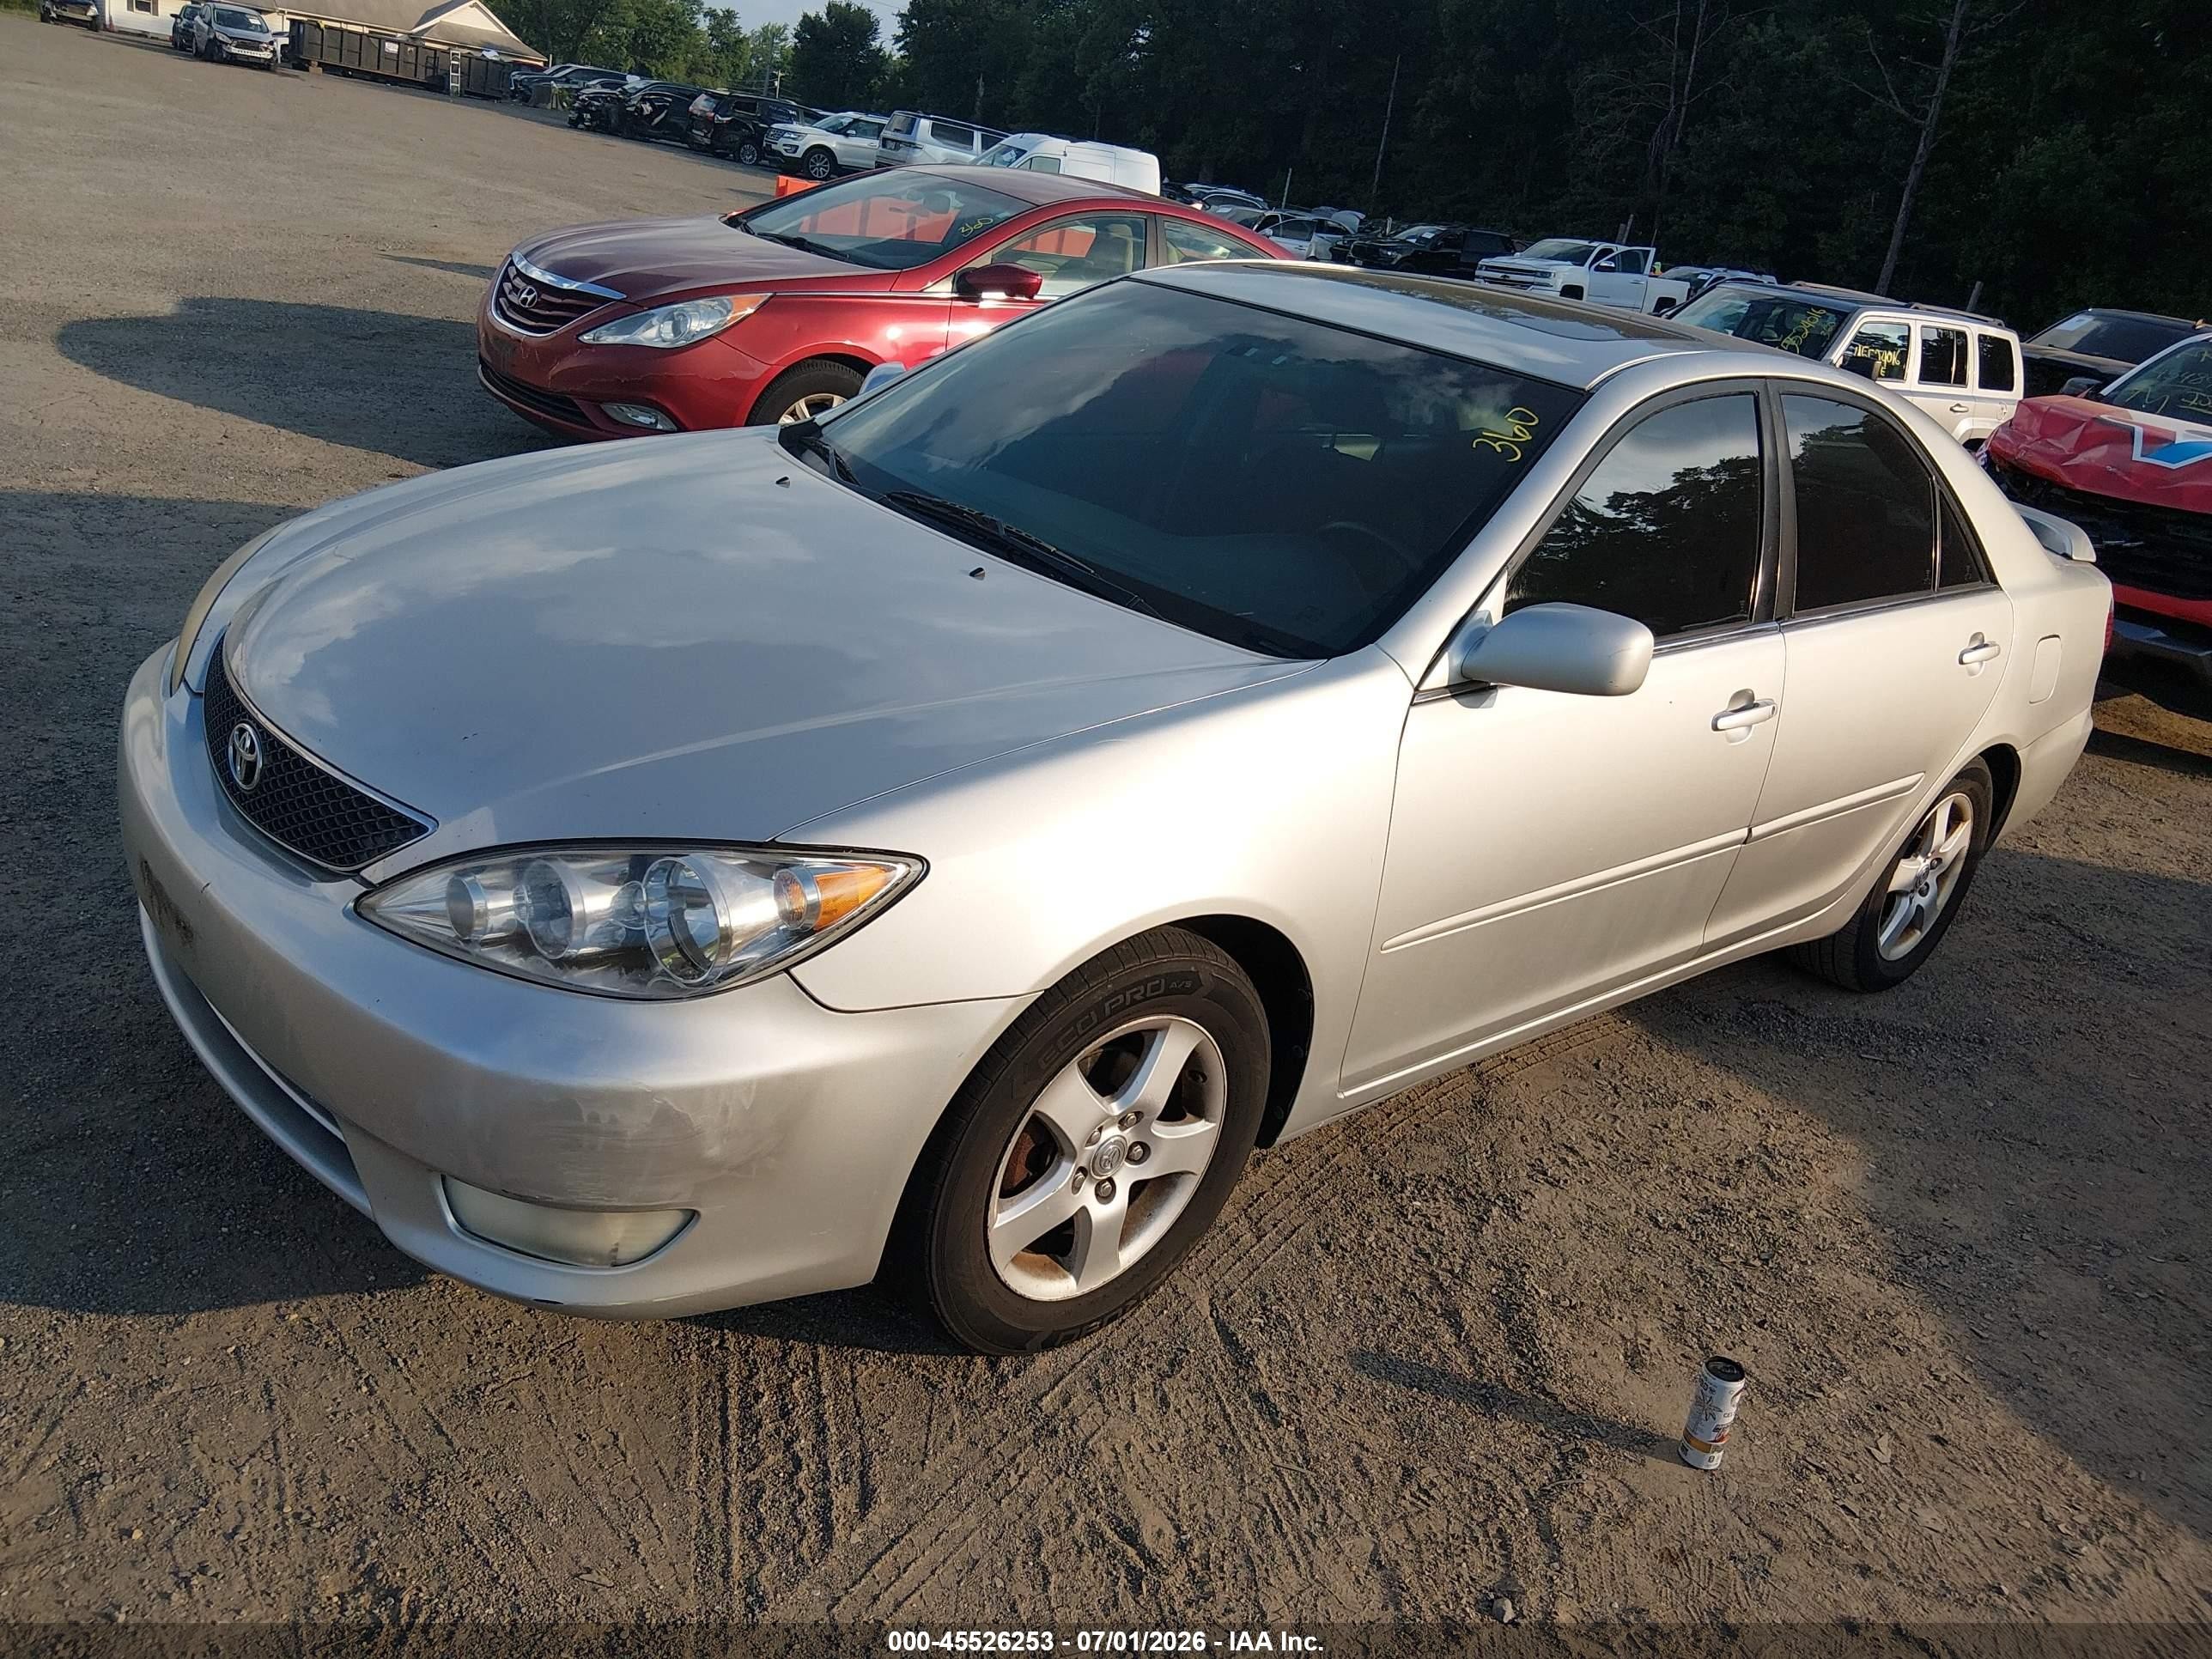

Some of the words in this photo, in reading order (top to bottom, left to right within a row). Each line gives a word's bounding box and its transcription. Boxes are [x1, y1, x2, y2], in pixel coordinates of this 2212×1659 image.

[1472, 406, 1540, 463] 360
[1039, 1011, 1098, 1070] ECO
[1103, 977, 1166, 1016] PRO
